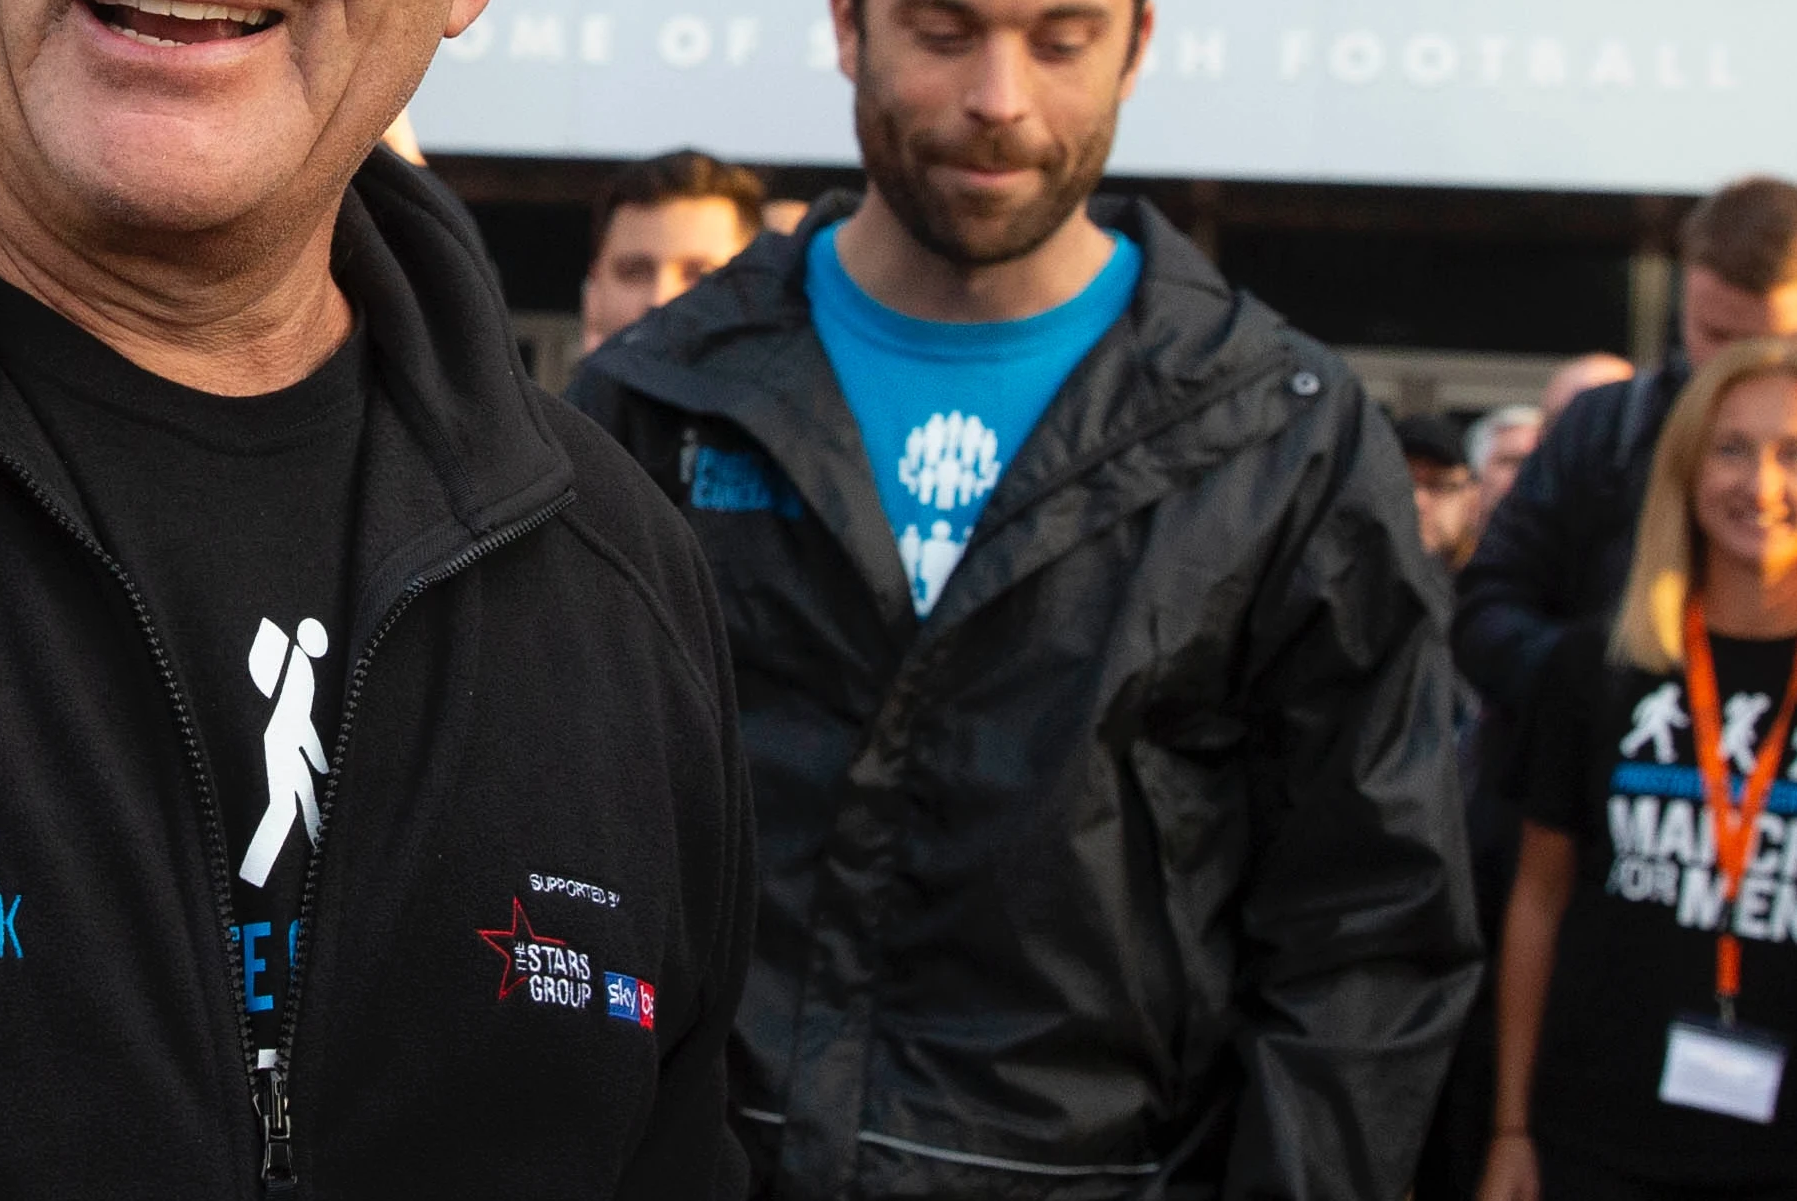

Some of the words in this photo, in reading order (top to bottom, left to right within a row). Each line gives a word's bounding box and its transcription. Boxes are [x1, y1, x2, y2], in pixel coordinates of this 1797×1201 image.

[1280, 28, 1739, 90] FOOTBALL
[529, 873, 607, 904] SUPPORTED
[514, 940, 529, 972] THE
[527, 943, 592, 981] STARS
[529, 974, 592, 1009] GROUP
[607, 977, 636, 1015] sky
